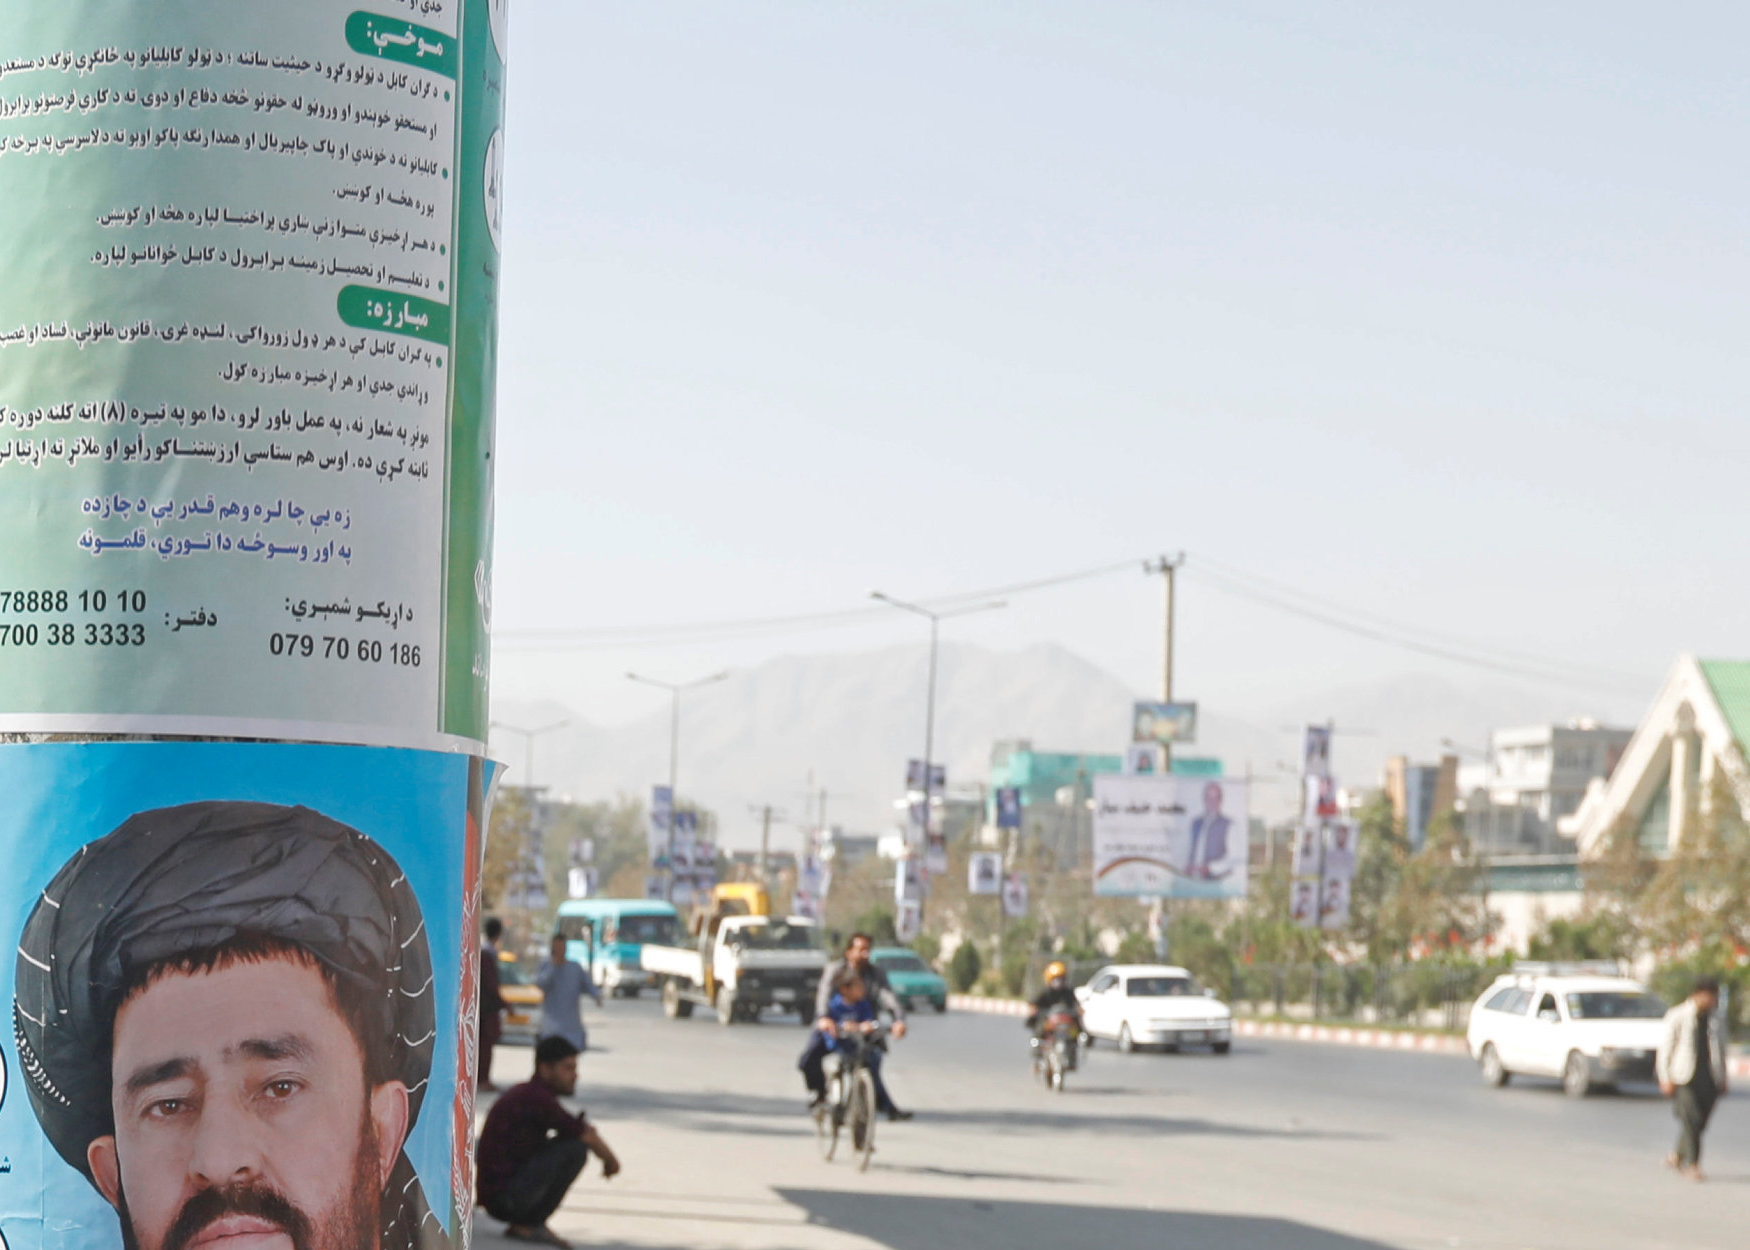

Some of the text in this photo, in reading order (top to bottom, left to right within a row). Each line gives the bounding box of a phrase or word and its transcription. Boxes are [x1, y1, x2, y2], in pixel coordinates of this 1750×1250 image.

[78, 589, 107, 612] 10
[117, 590, 146, 613] 10
[47, 623, 75, 646] 38
[84, 623, 146, 646] 3333
[269, 632, 421, 667] 079 70 60 186
